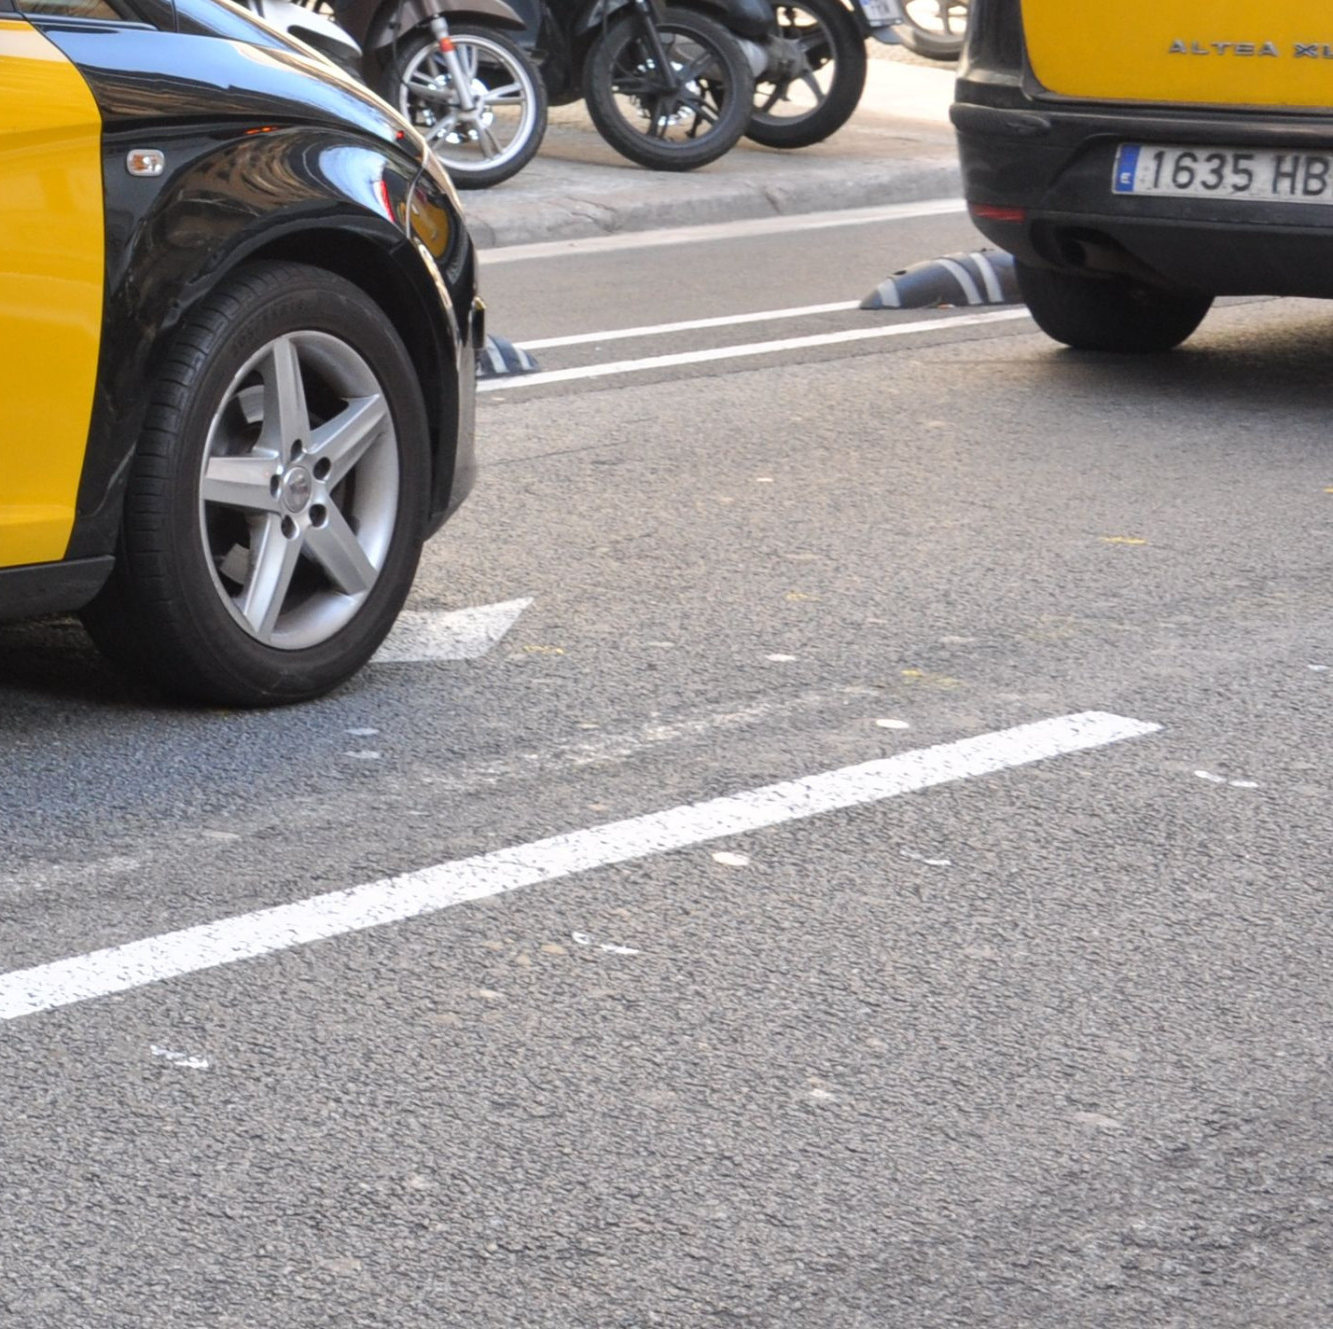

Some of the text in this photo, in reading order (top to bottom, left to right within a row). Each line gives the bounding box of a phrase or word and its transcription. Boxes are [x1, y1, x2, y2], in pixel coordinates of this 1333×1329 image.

[1168, 39, 1280, 58] ALTEA
[1152, 150, 1256, 193] 1635
[1270, 153, 1333, 197] HB
